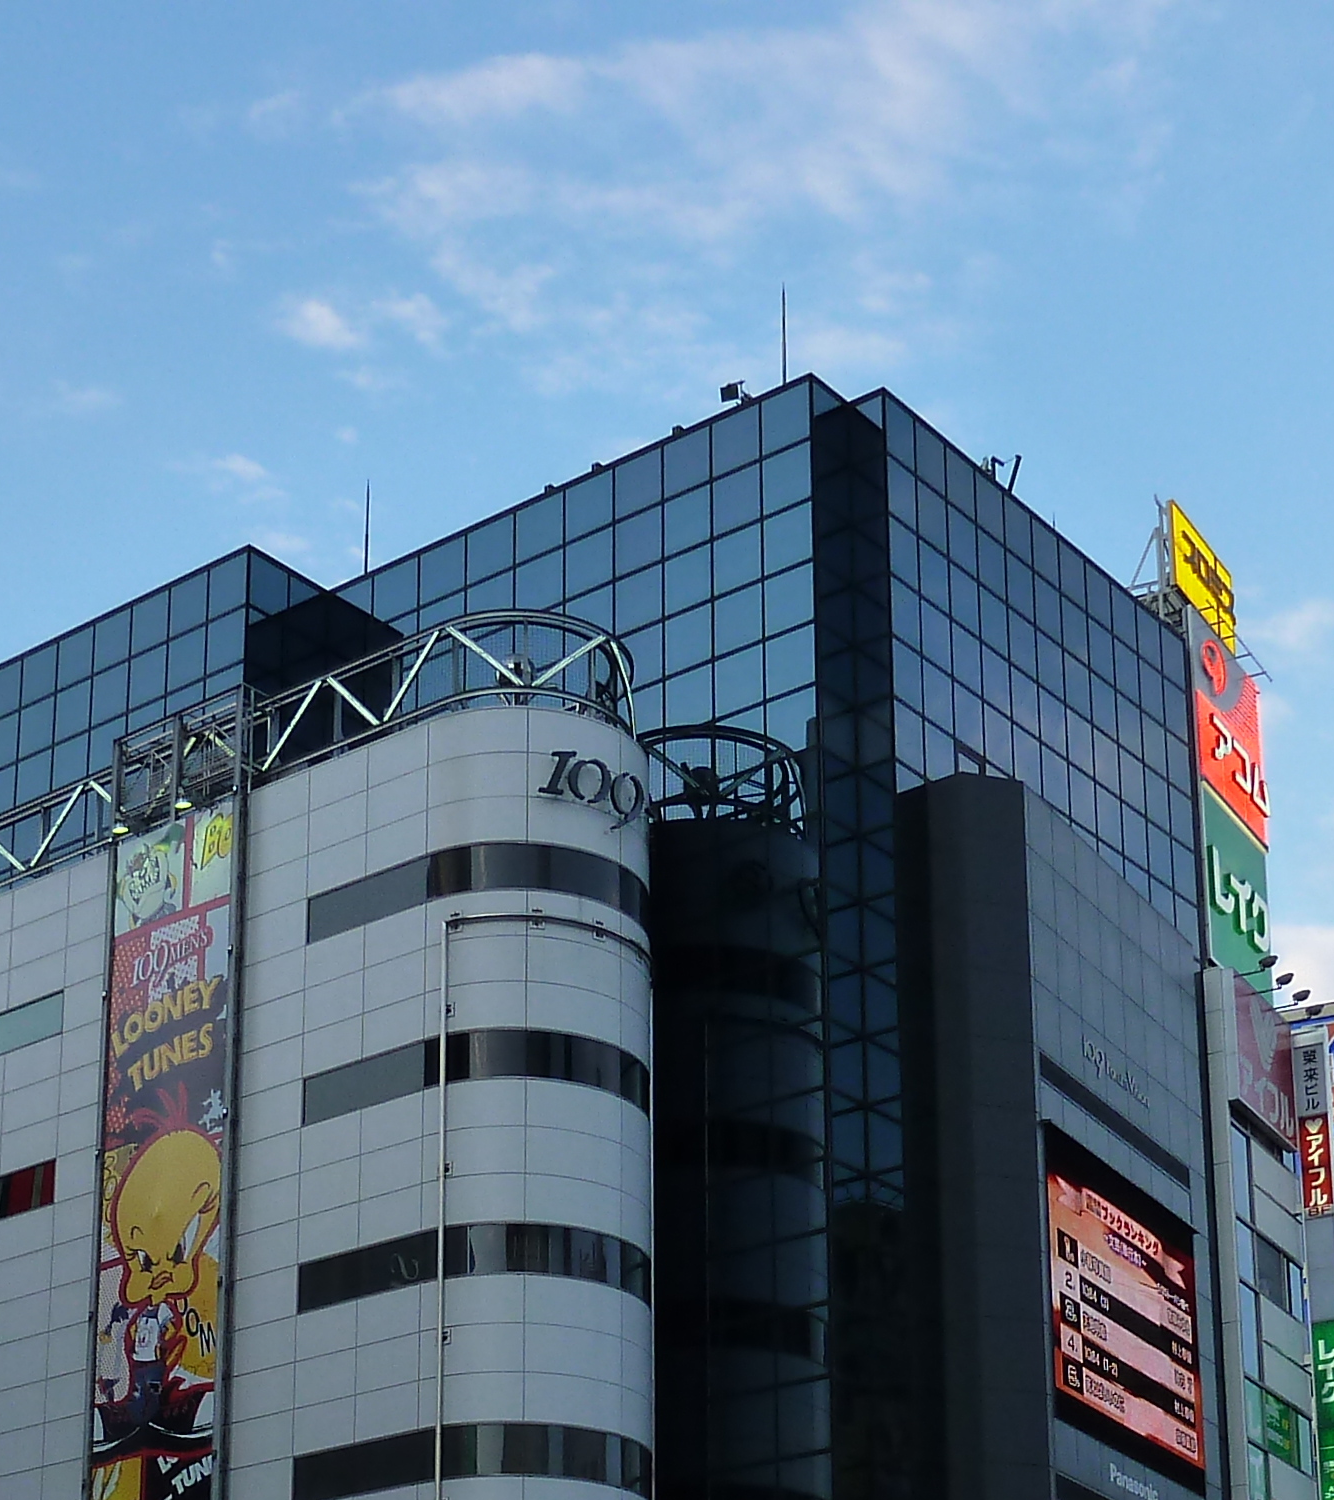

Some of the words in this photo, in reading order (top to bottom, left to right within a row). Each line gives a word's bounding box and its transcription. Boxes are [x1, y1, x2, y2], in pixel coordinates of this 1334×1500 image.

[538, 750, 644, 830] 109
[1209, 713, 1271, 818] アコム
[1208, 844, 1269, 953] レイク
[111, 976, 222, 1058] LOONEY
[127, 1022, 215, 1092] TUNES
[1305, 1134, 1328, 1206] アイフル
[172, 1454, 214, 1495] TUN
